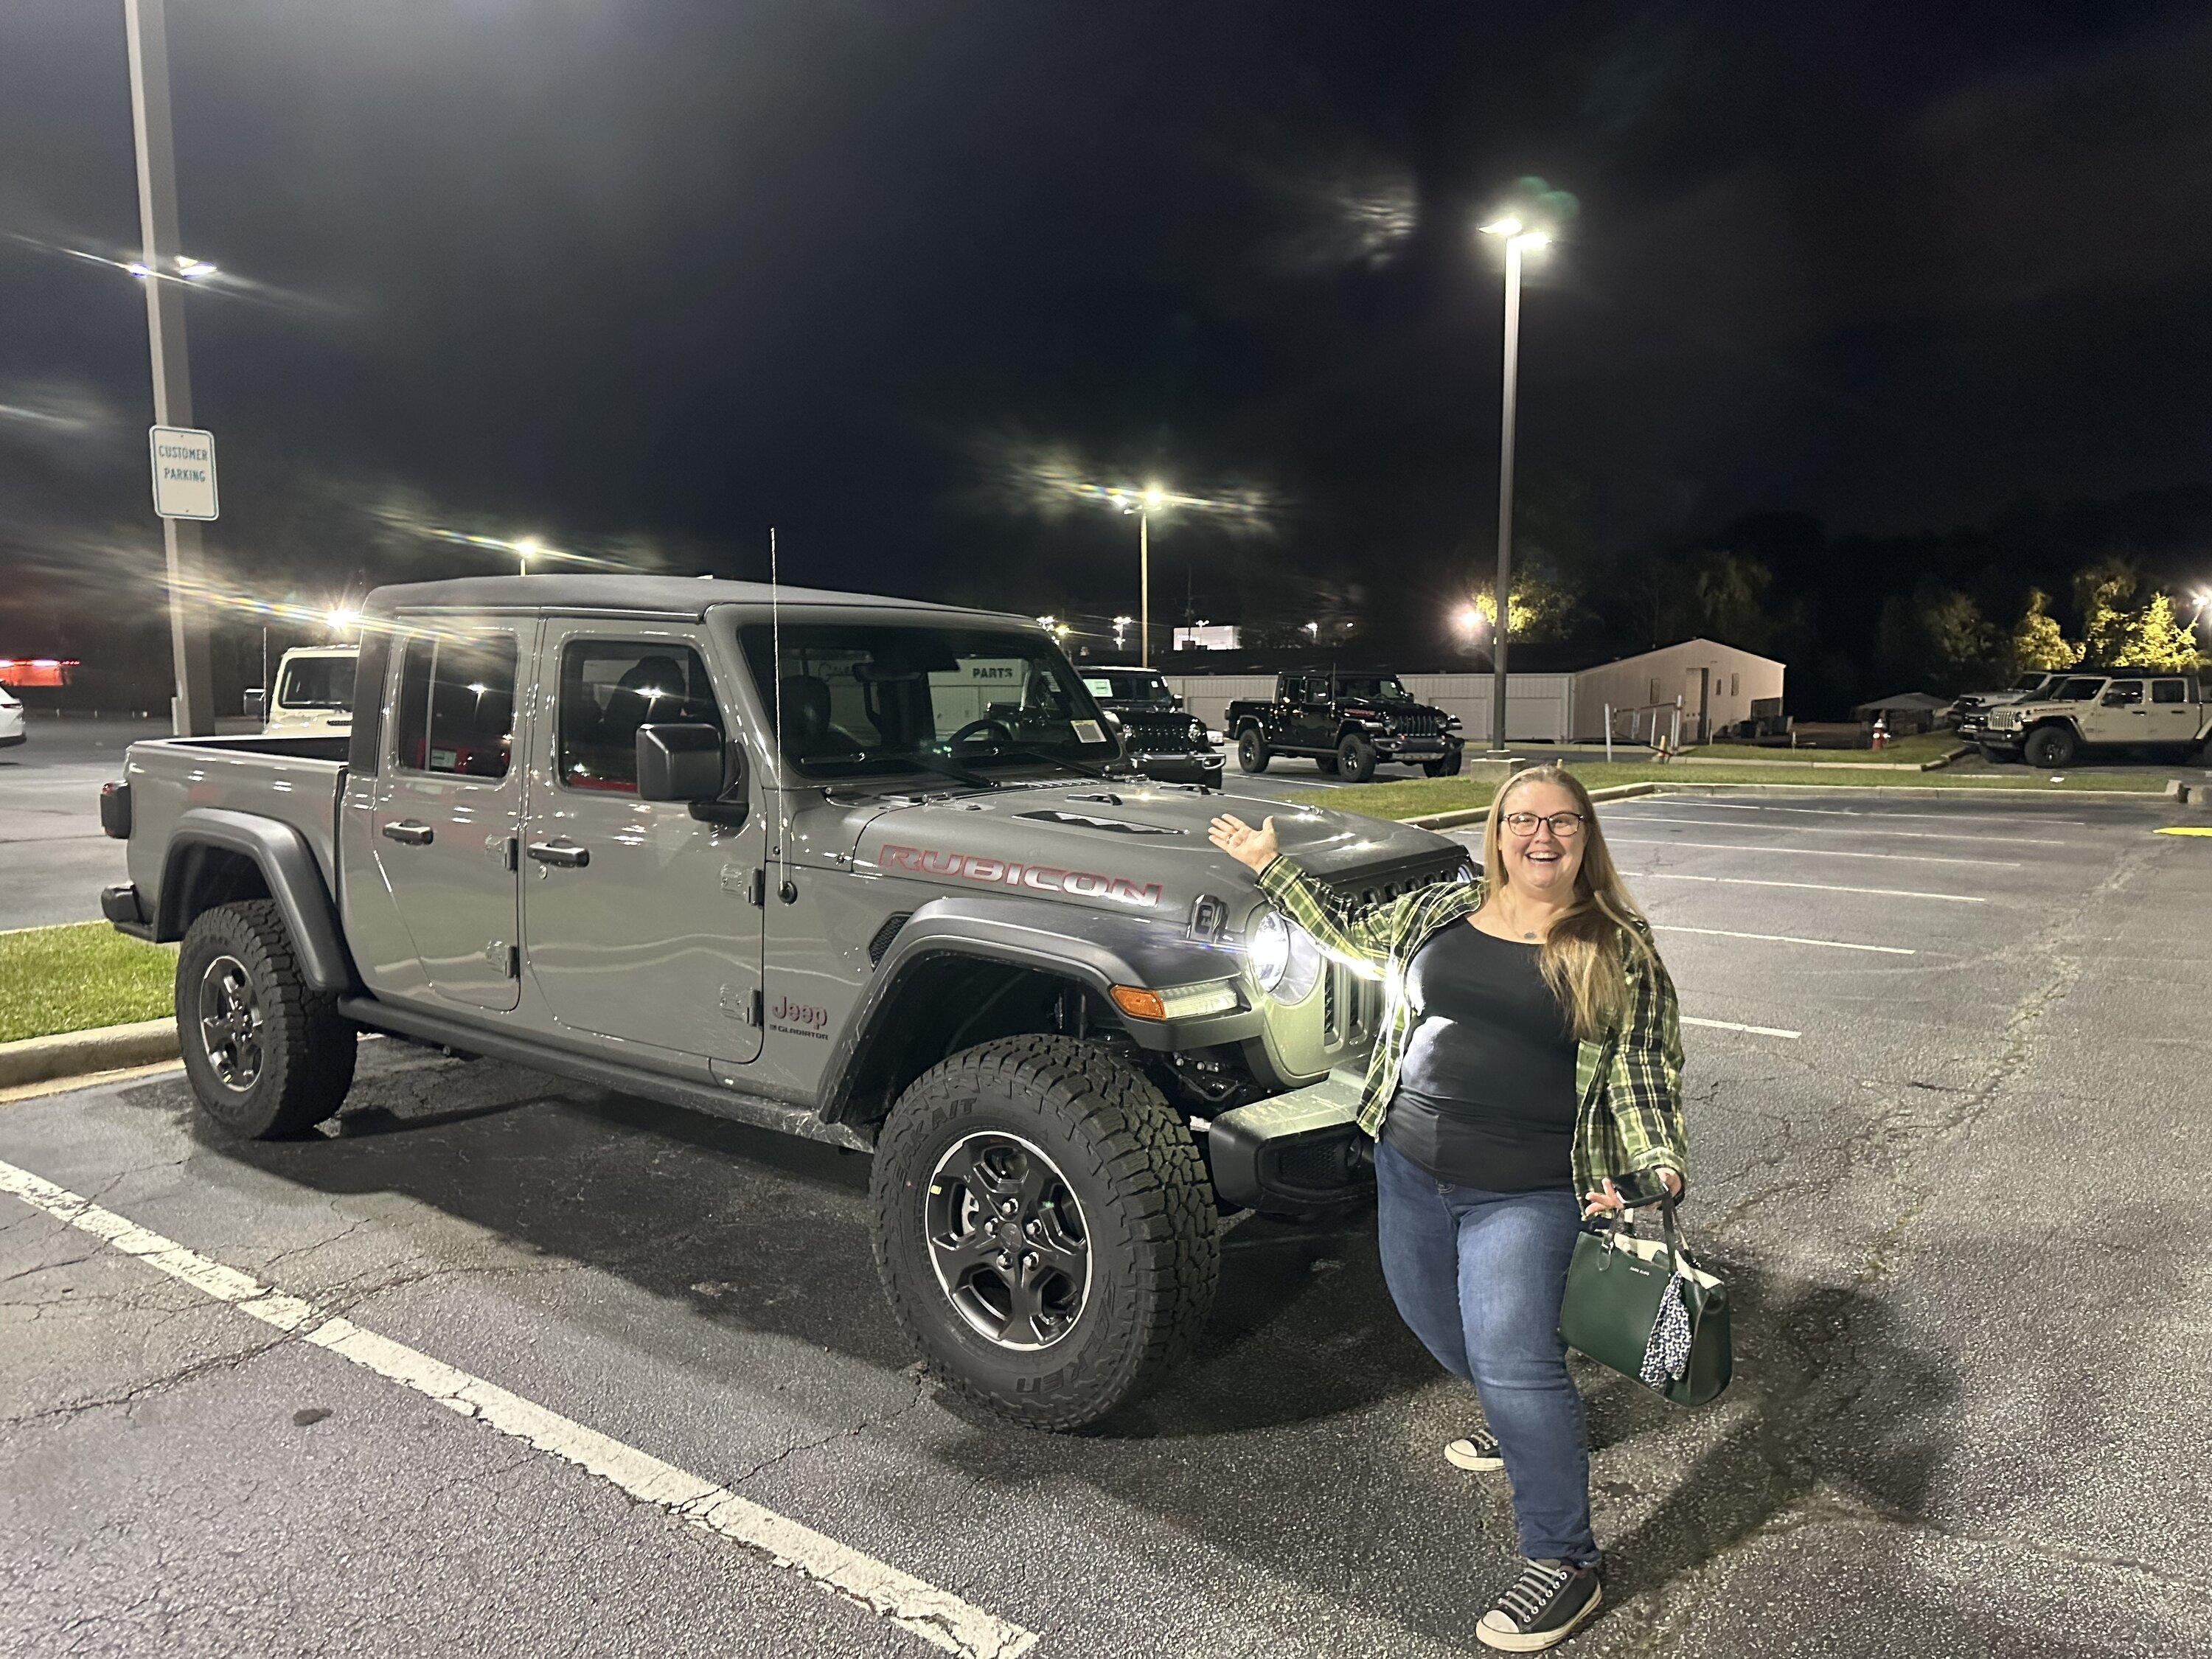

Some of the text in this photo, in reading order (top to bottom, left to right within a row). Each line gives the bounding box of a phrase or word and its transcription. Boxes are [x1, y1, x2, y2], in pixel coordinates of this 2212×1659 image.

[159, 445, 208, 461] CUSTOMER
[164, 467, 206, 482] PARKING
[973, 667, 1012, 678] PARTS
[878, 844, 1163, 908] RUBICON
[773, 996, 827, 1029] Jeep
[777, 1026, 828, 1040] GLADIATOR
